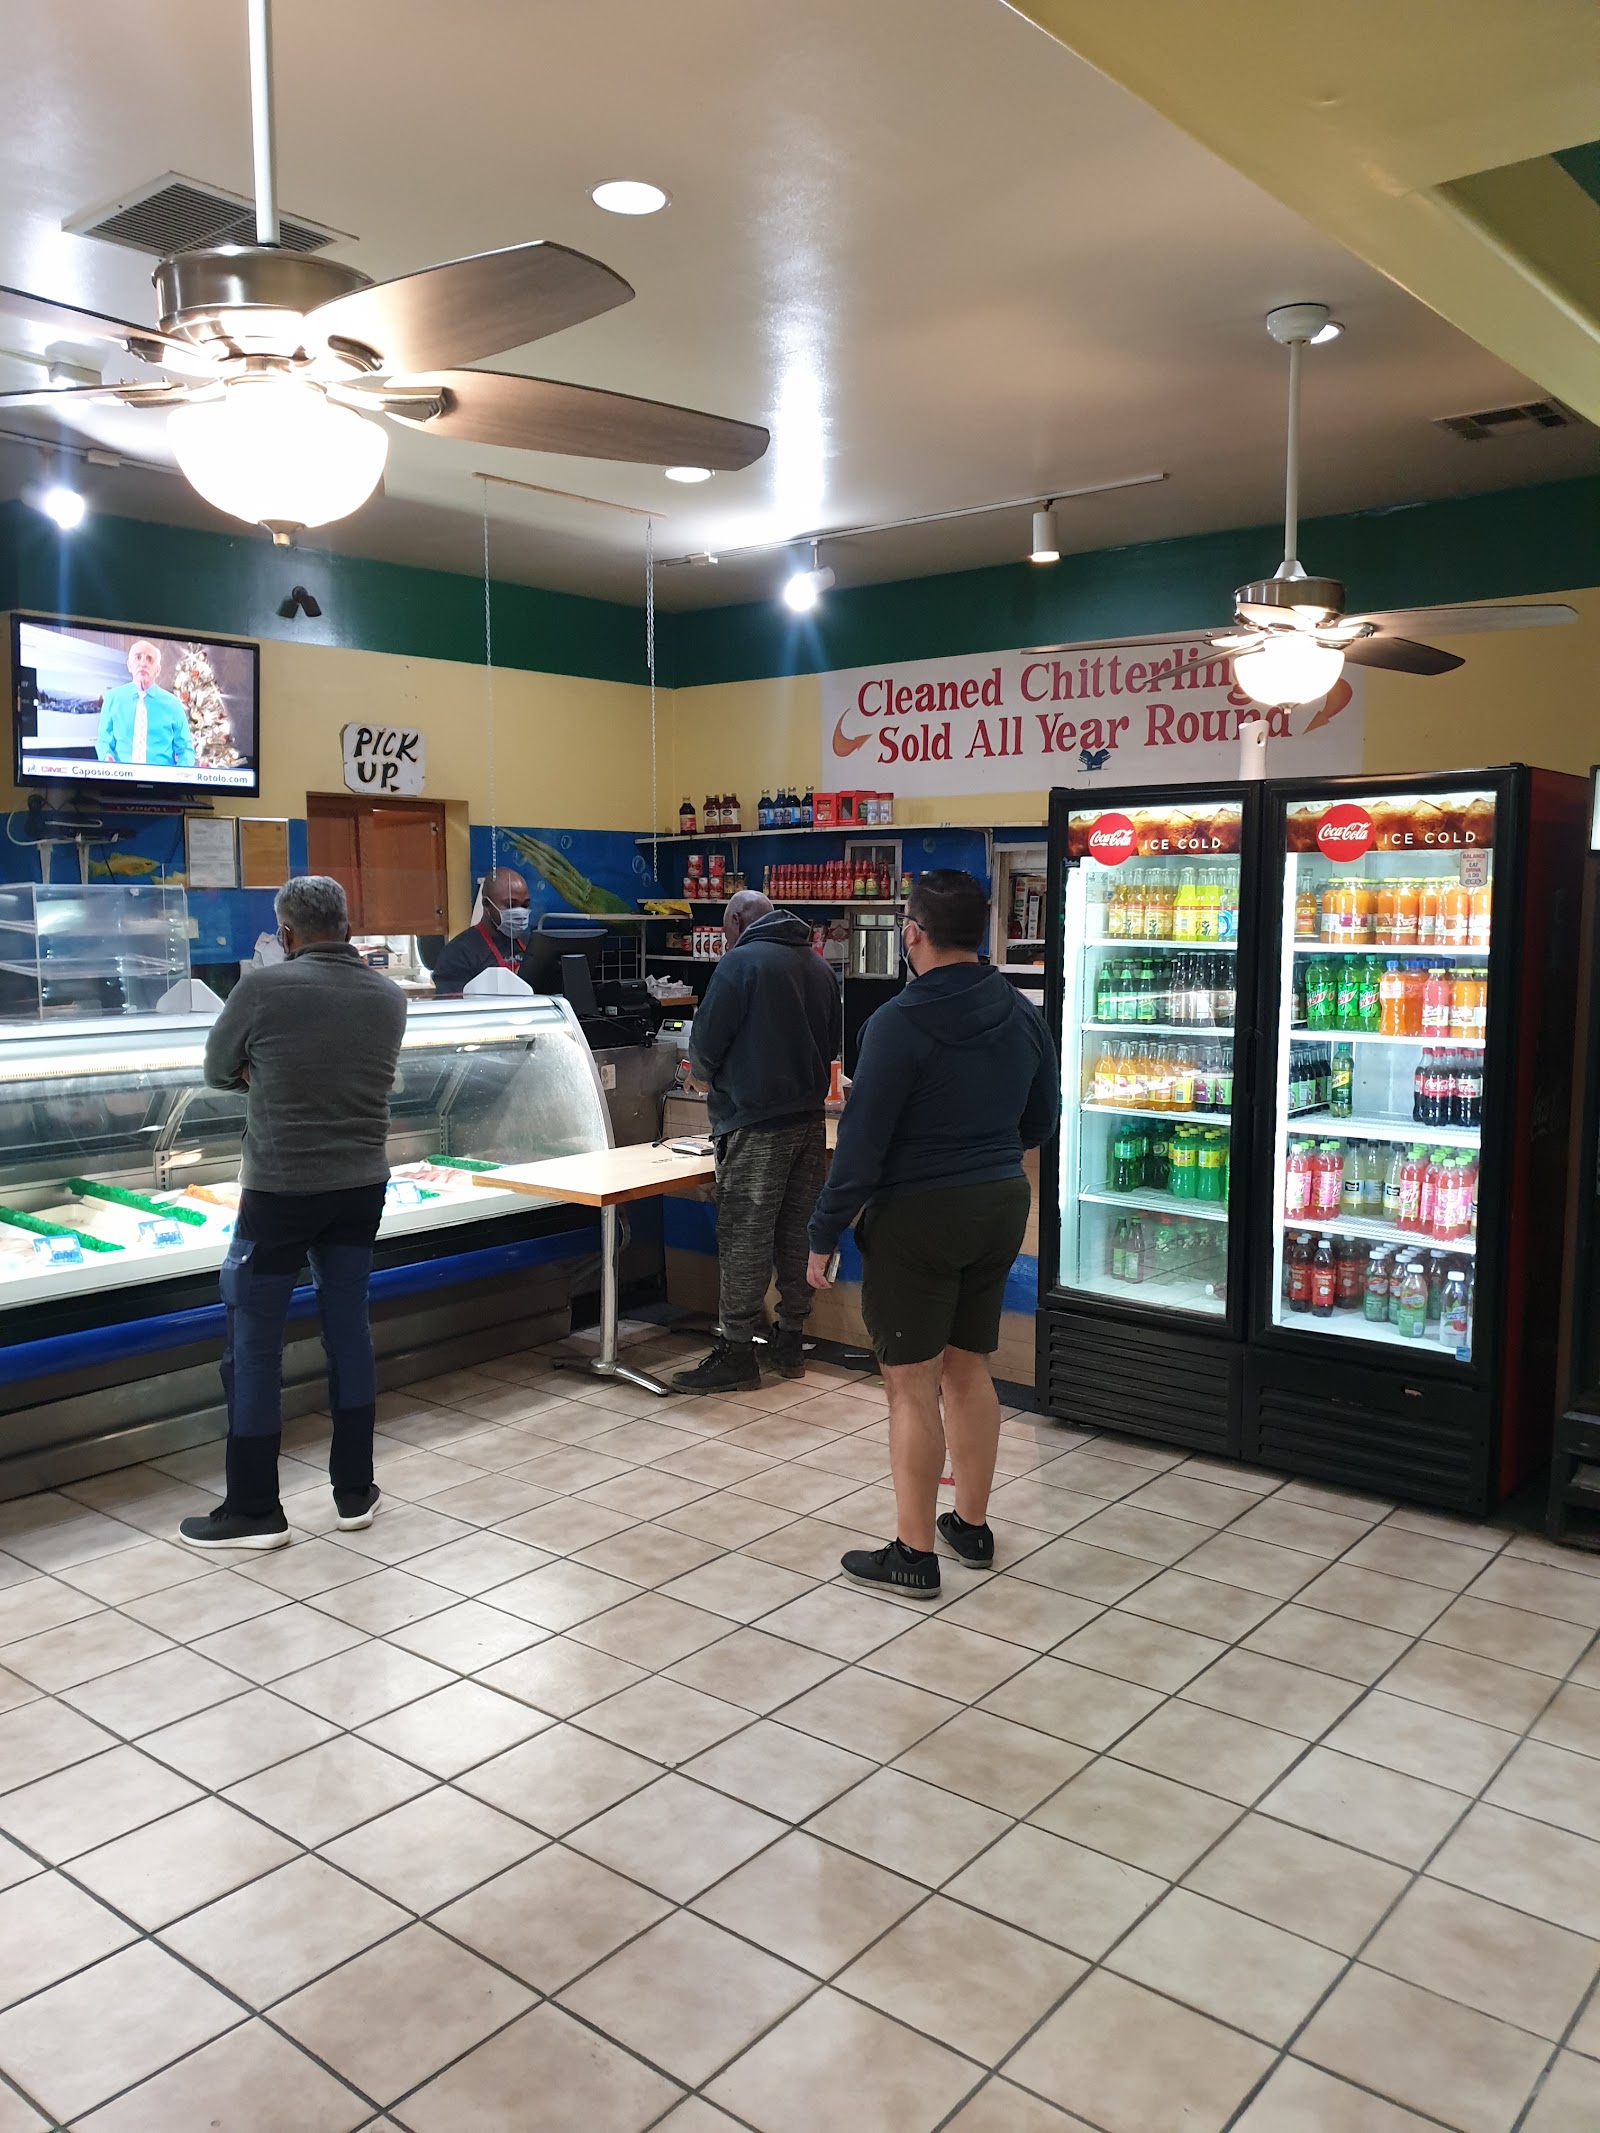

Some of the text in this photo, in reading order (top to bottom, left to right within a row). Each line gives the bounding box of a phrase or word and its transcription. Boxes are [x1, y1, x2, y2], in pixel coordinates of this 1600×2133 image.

[857, 667, 1004, 717] Cleaned
[353, 727, 419, 763] PICK
[877, 722, 953, 764] Sold
[964, 716, 1024, 759] All
[1035, 712, 1130, 754] Year
[71, 765, 134, 779] Caposio.com
[196, 773, 248, 785] Rotolo.com
[357, 761, 399, 789] UP
[1089, 829, 1135, 848] Coca-Cola
[1317, 821, 1372, 842] Coca-Cola
[1383, 831, 1477, 845] ICE COLD
[1143, 836, 1222, 851] ICE COLD
